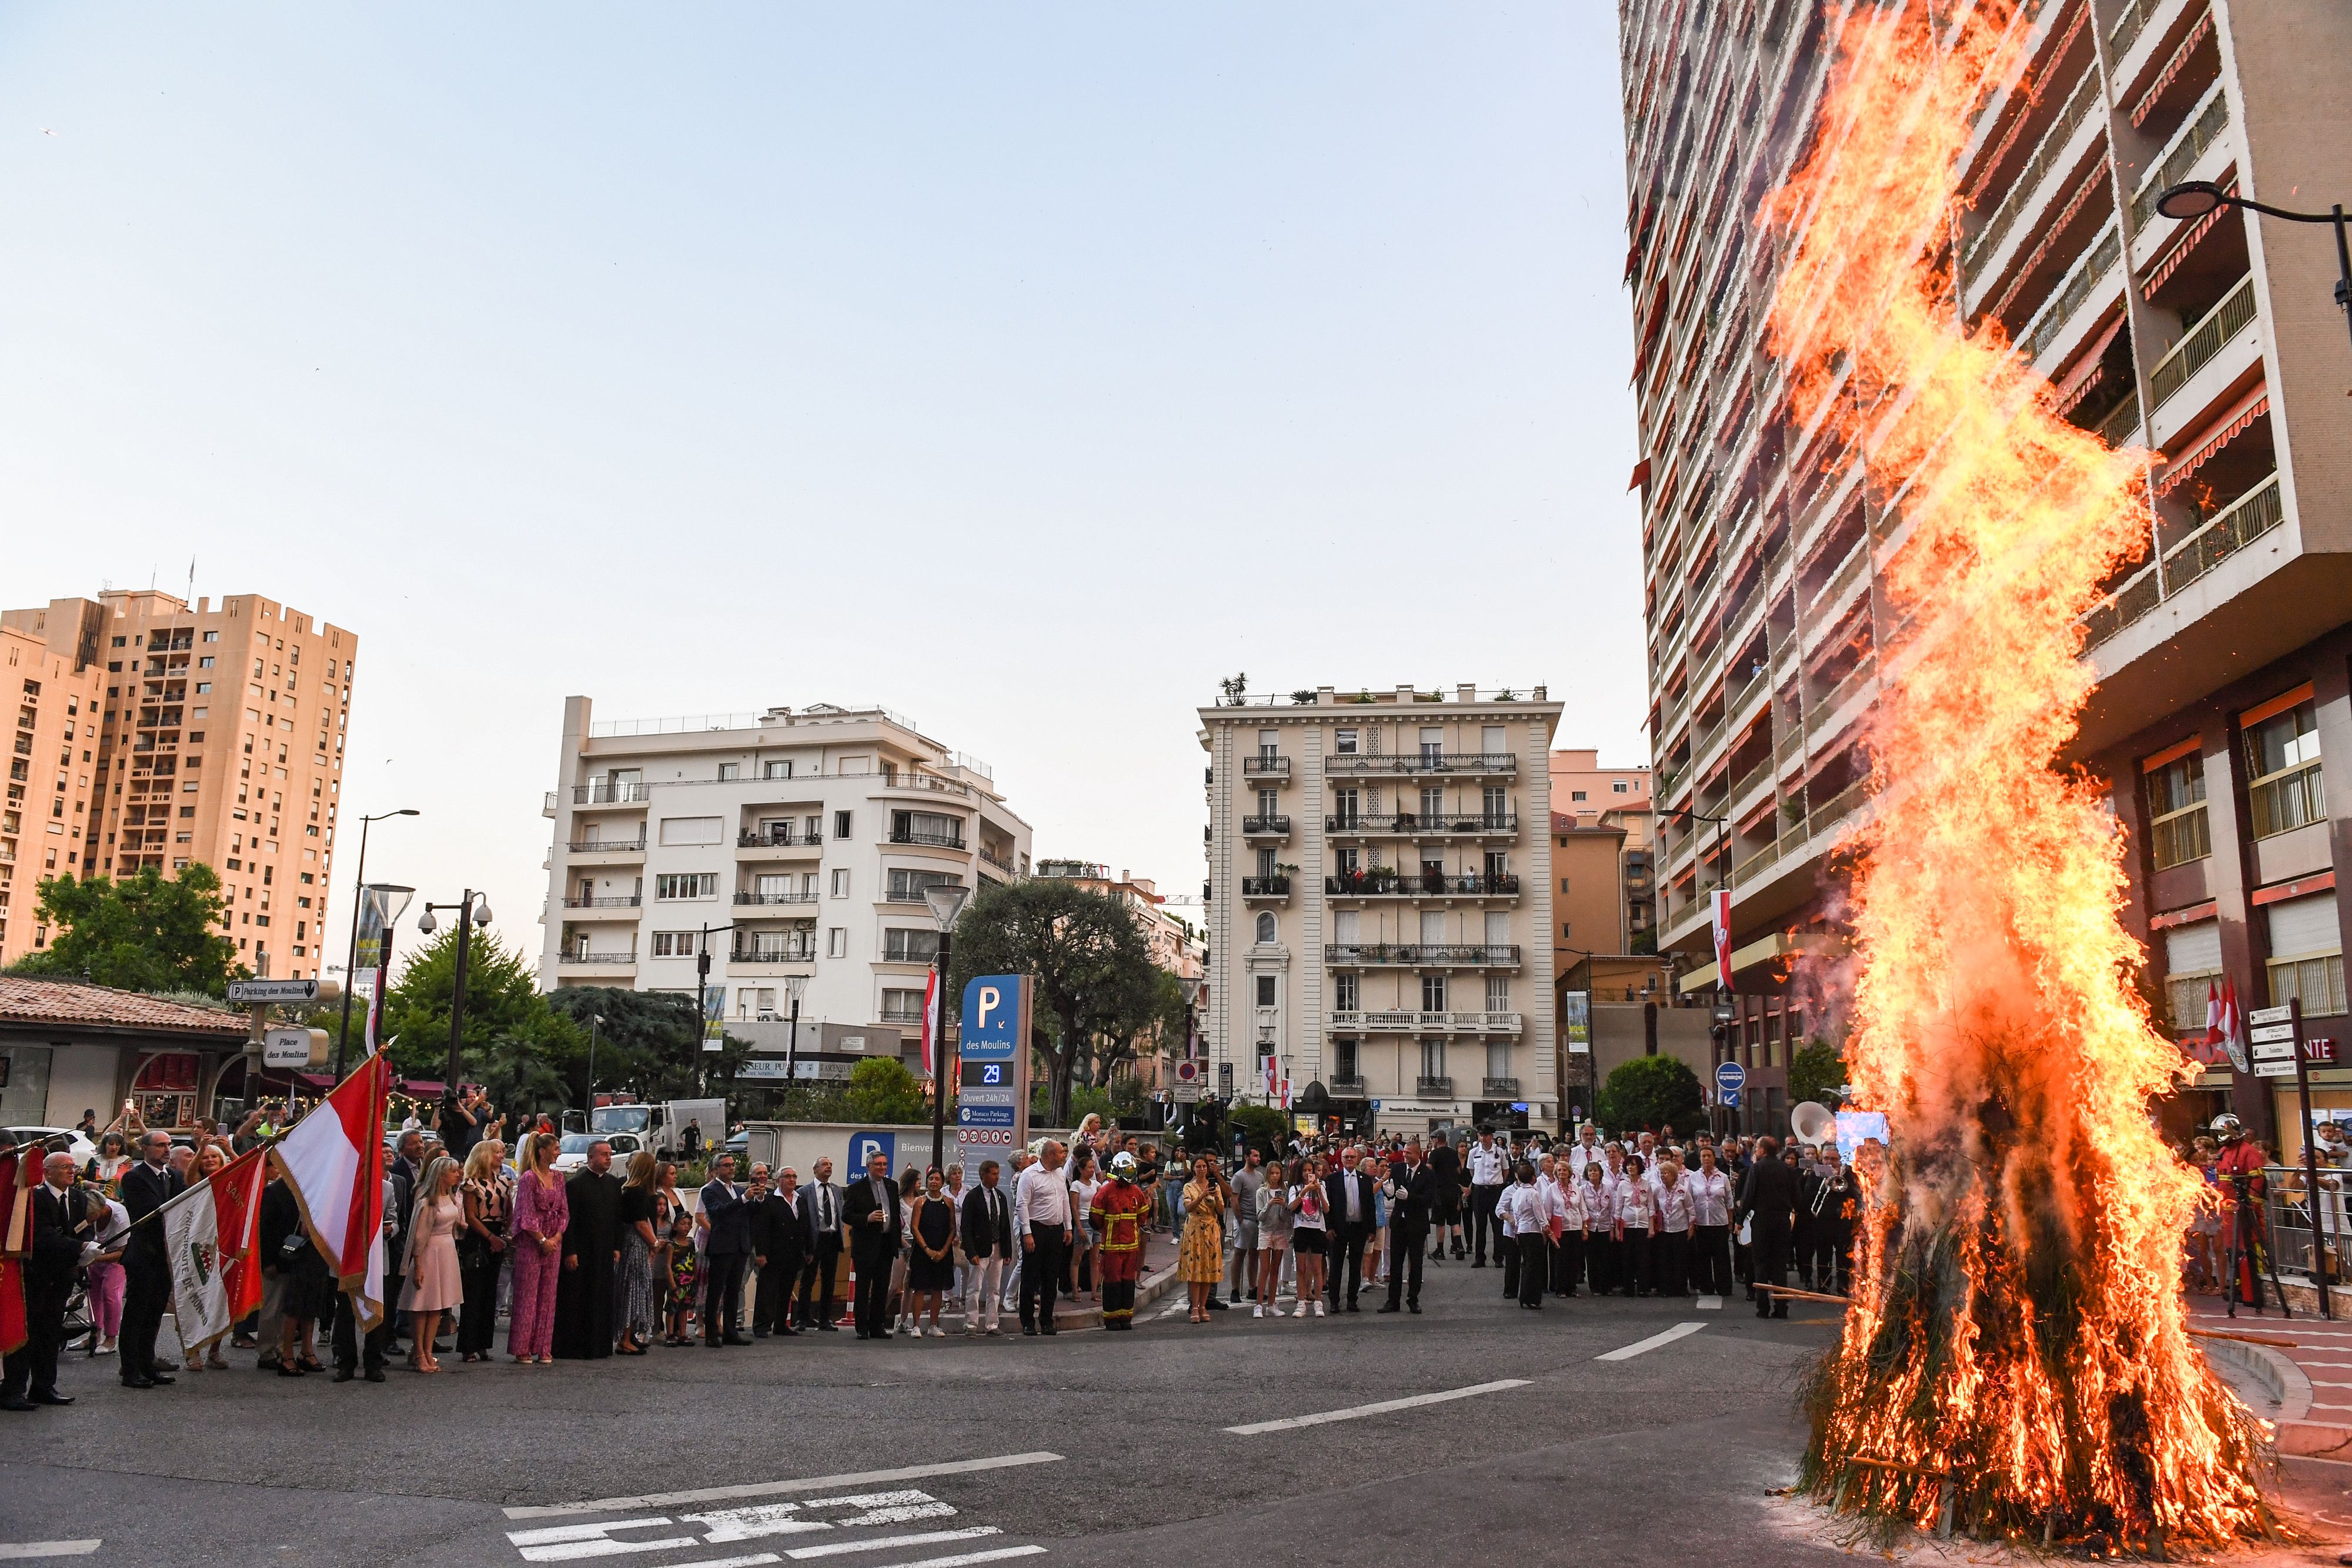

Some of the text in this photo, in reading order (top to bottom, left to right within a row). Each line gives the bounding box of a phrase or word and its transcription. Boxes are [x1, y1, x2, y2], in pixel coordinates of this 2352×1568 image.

[235, 987, 240, 997] P
[243, 988, 267, 997] Parking
[280, 987, 305, 995] Moulins
[978, 987, 1000, 1028] P
[966, 1039, 1010, 1050] des Moulins
[983, 1065, 1000, 1083] 29
[964, 1094, 1010, 1104] Ouvert 24h/24
[861, 1139, 881, 1167] P
[182, 1277, 195, 1292] DE
